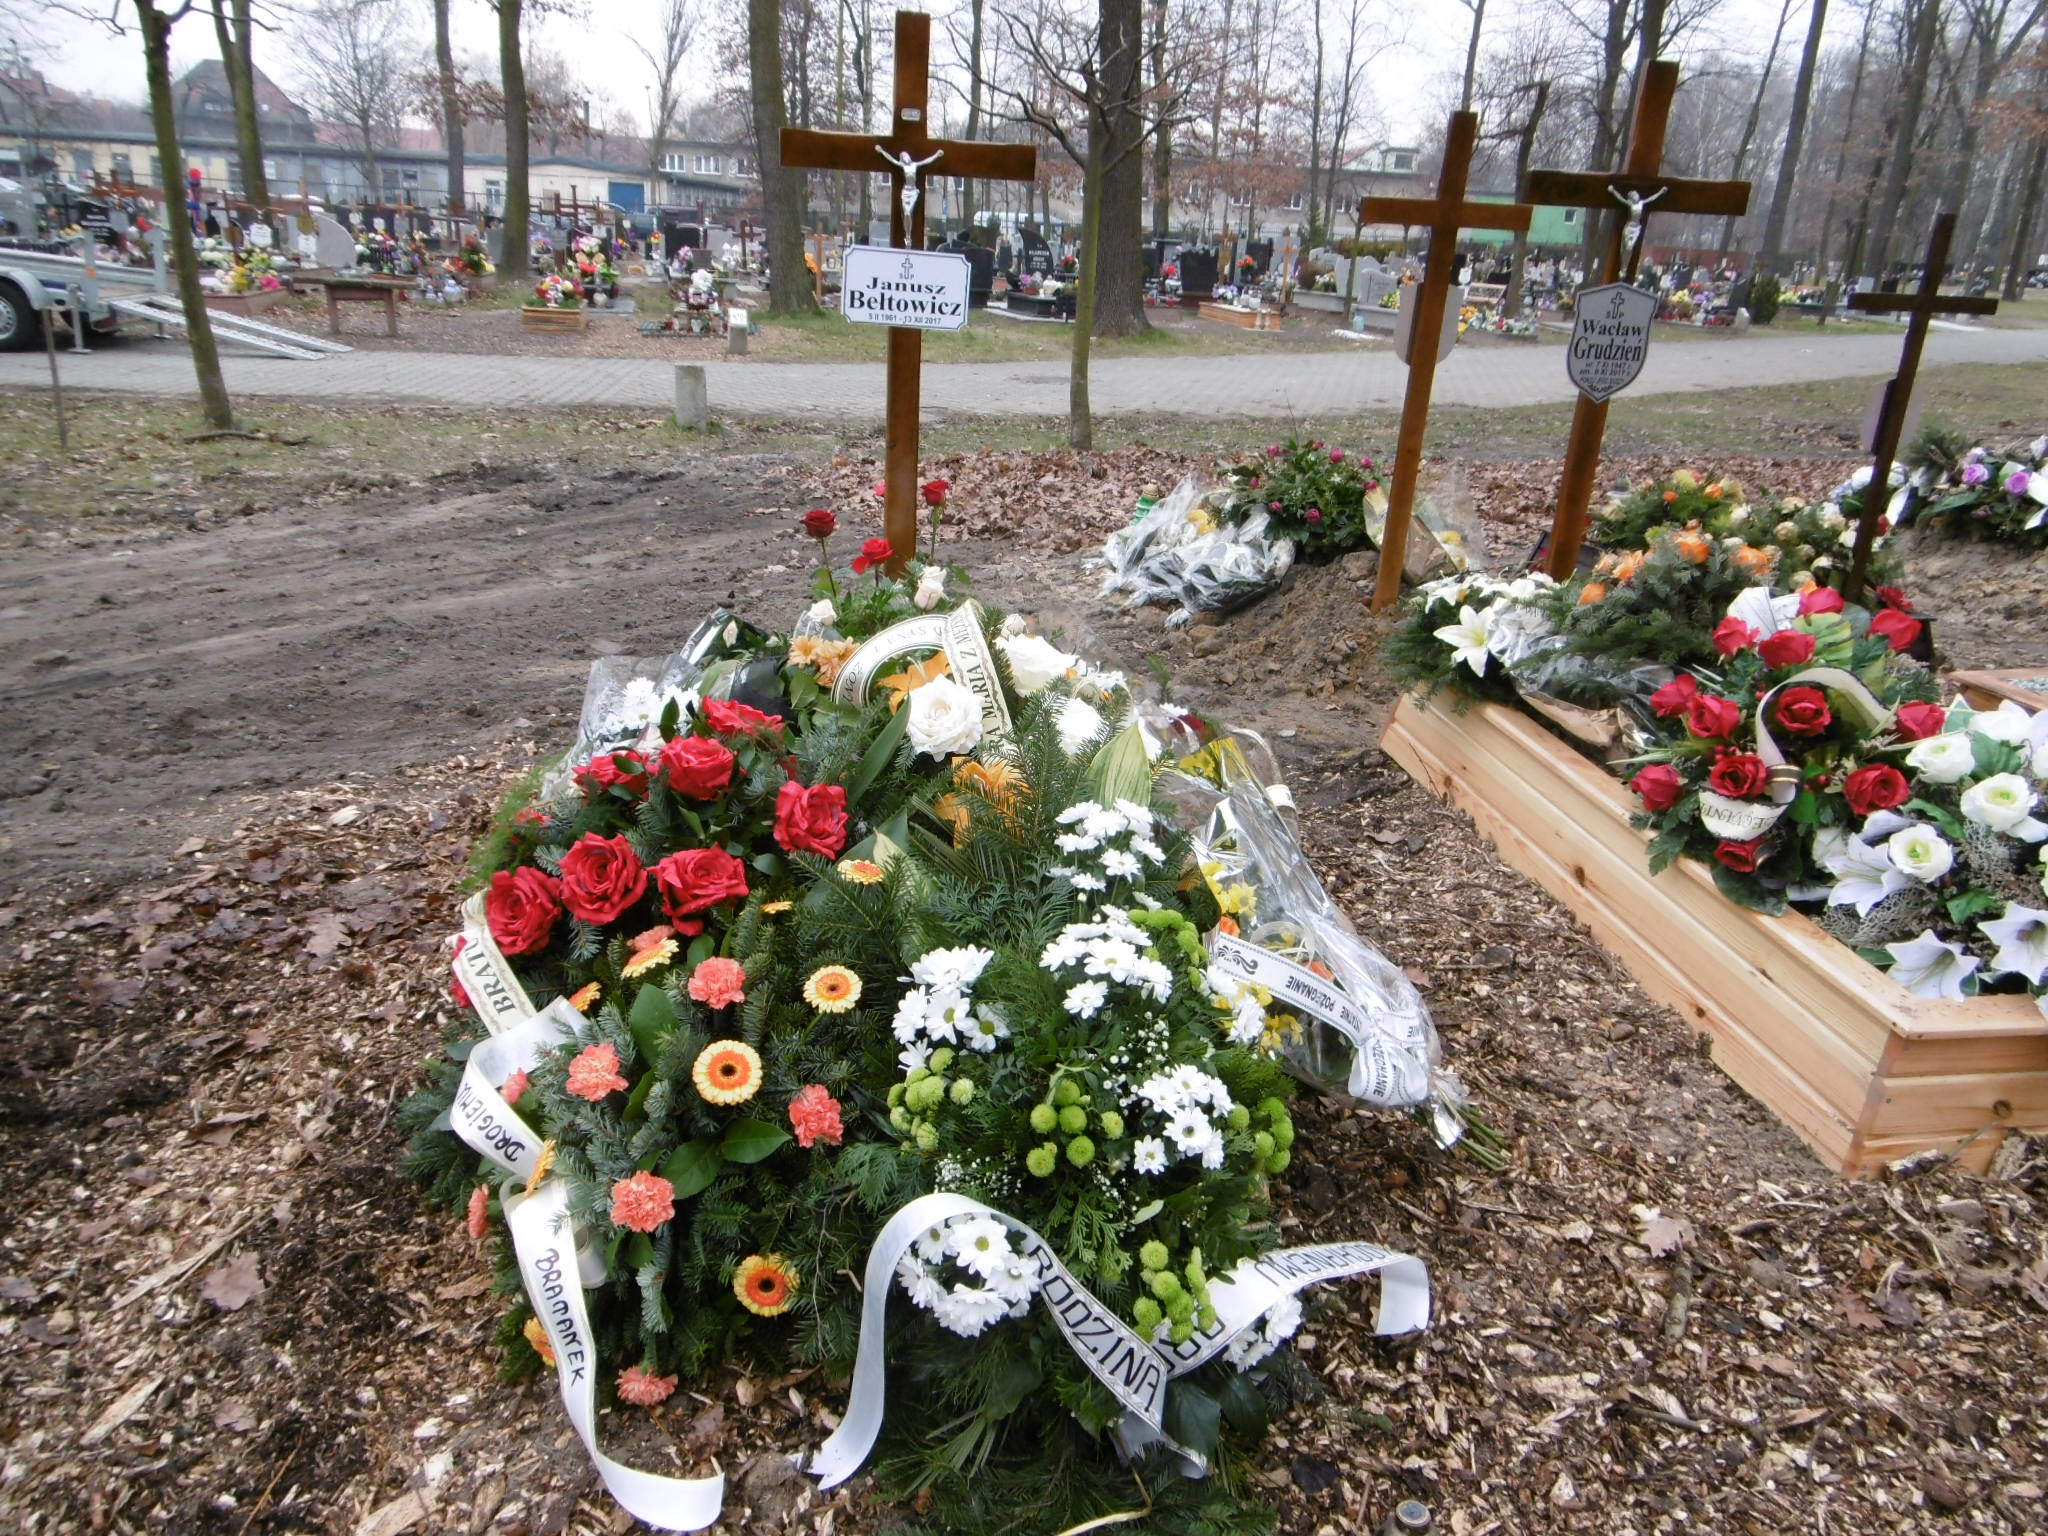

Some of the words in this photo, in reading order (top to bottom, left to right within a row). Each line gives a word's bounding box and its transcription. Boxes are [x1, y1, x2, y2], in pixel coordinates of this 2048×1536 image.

[866, 277, 946, 295] Janusz
[849, 290, 962, 317] Bełtowicz
[924, 317, 942, 325] 2017
[1583, 320, 1645, 336] Wacław
[1574, 336, 1641, 361] Grudzień
[967, 663, 996, 721] MRIA
[535, 1247, 585, 1387] BRATANEK
[1027, 1243, 1161, 1413] RODZINA
